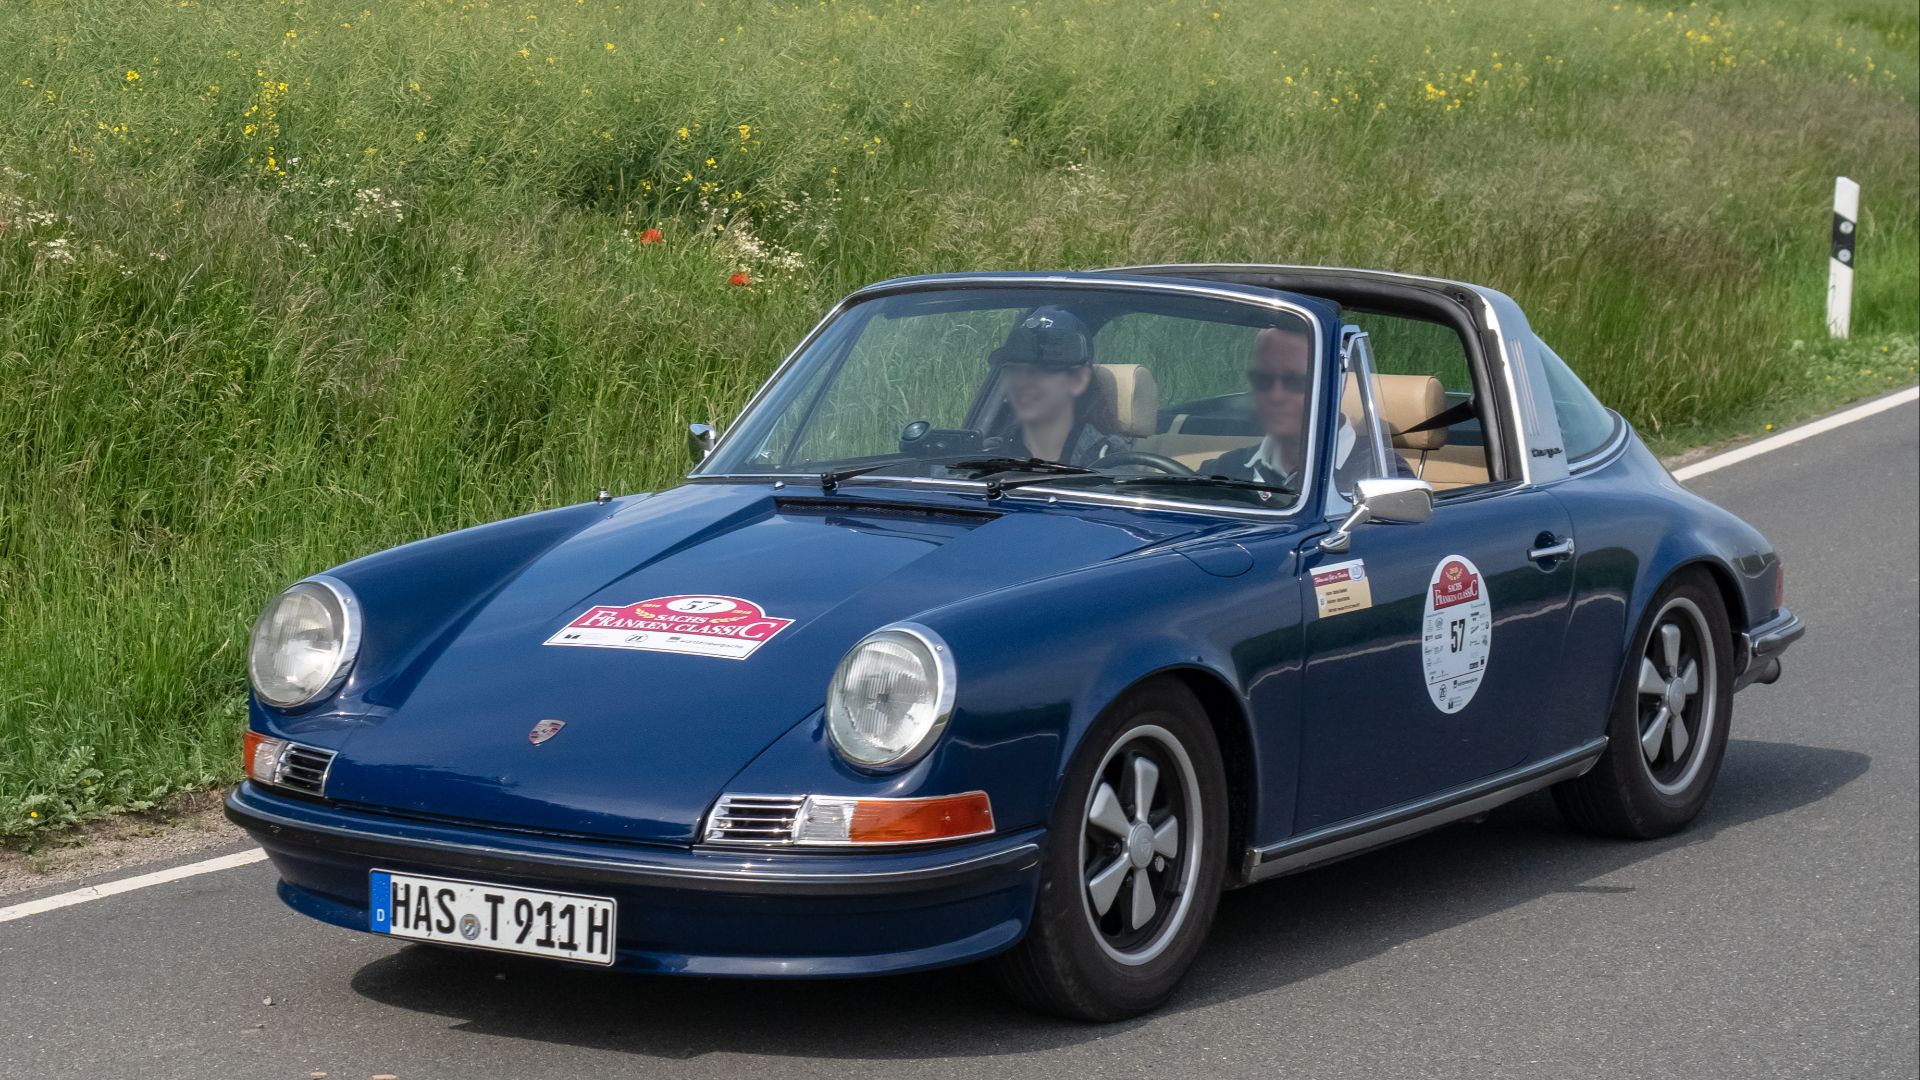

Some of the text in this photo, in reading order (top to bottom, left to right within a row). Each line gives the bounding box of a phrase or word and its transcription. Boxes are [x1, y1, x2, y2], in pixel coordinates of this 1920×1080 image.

[679, 600, 722, 611] 57
[578, 610, 778, 639] FRANKEN CLASSIC
[656, 614, 710, 624] SACHS
[1450, 618, 1466, 653] 57
[376, 908, 385, 922] D
[391, 881, 610, 955] HAS T 911H
